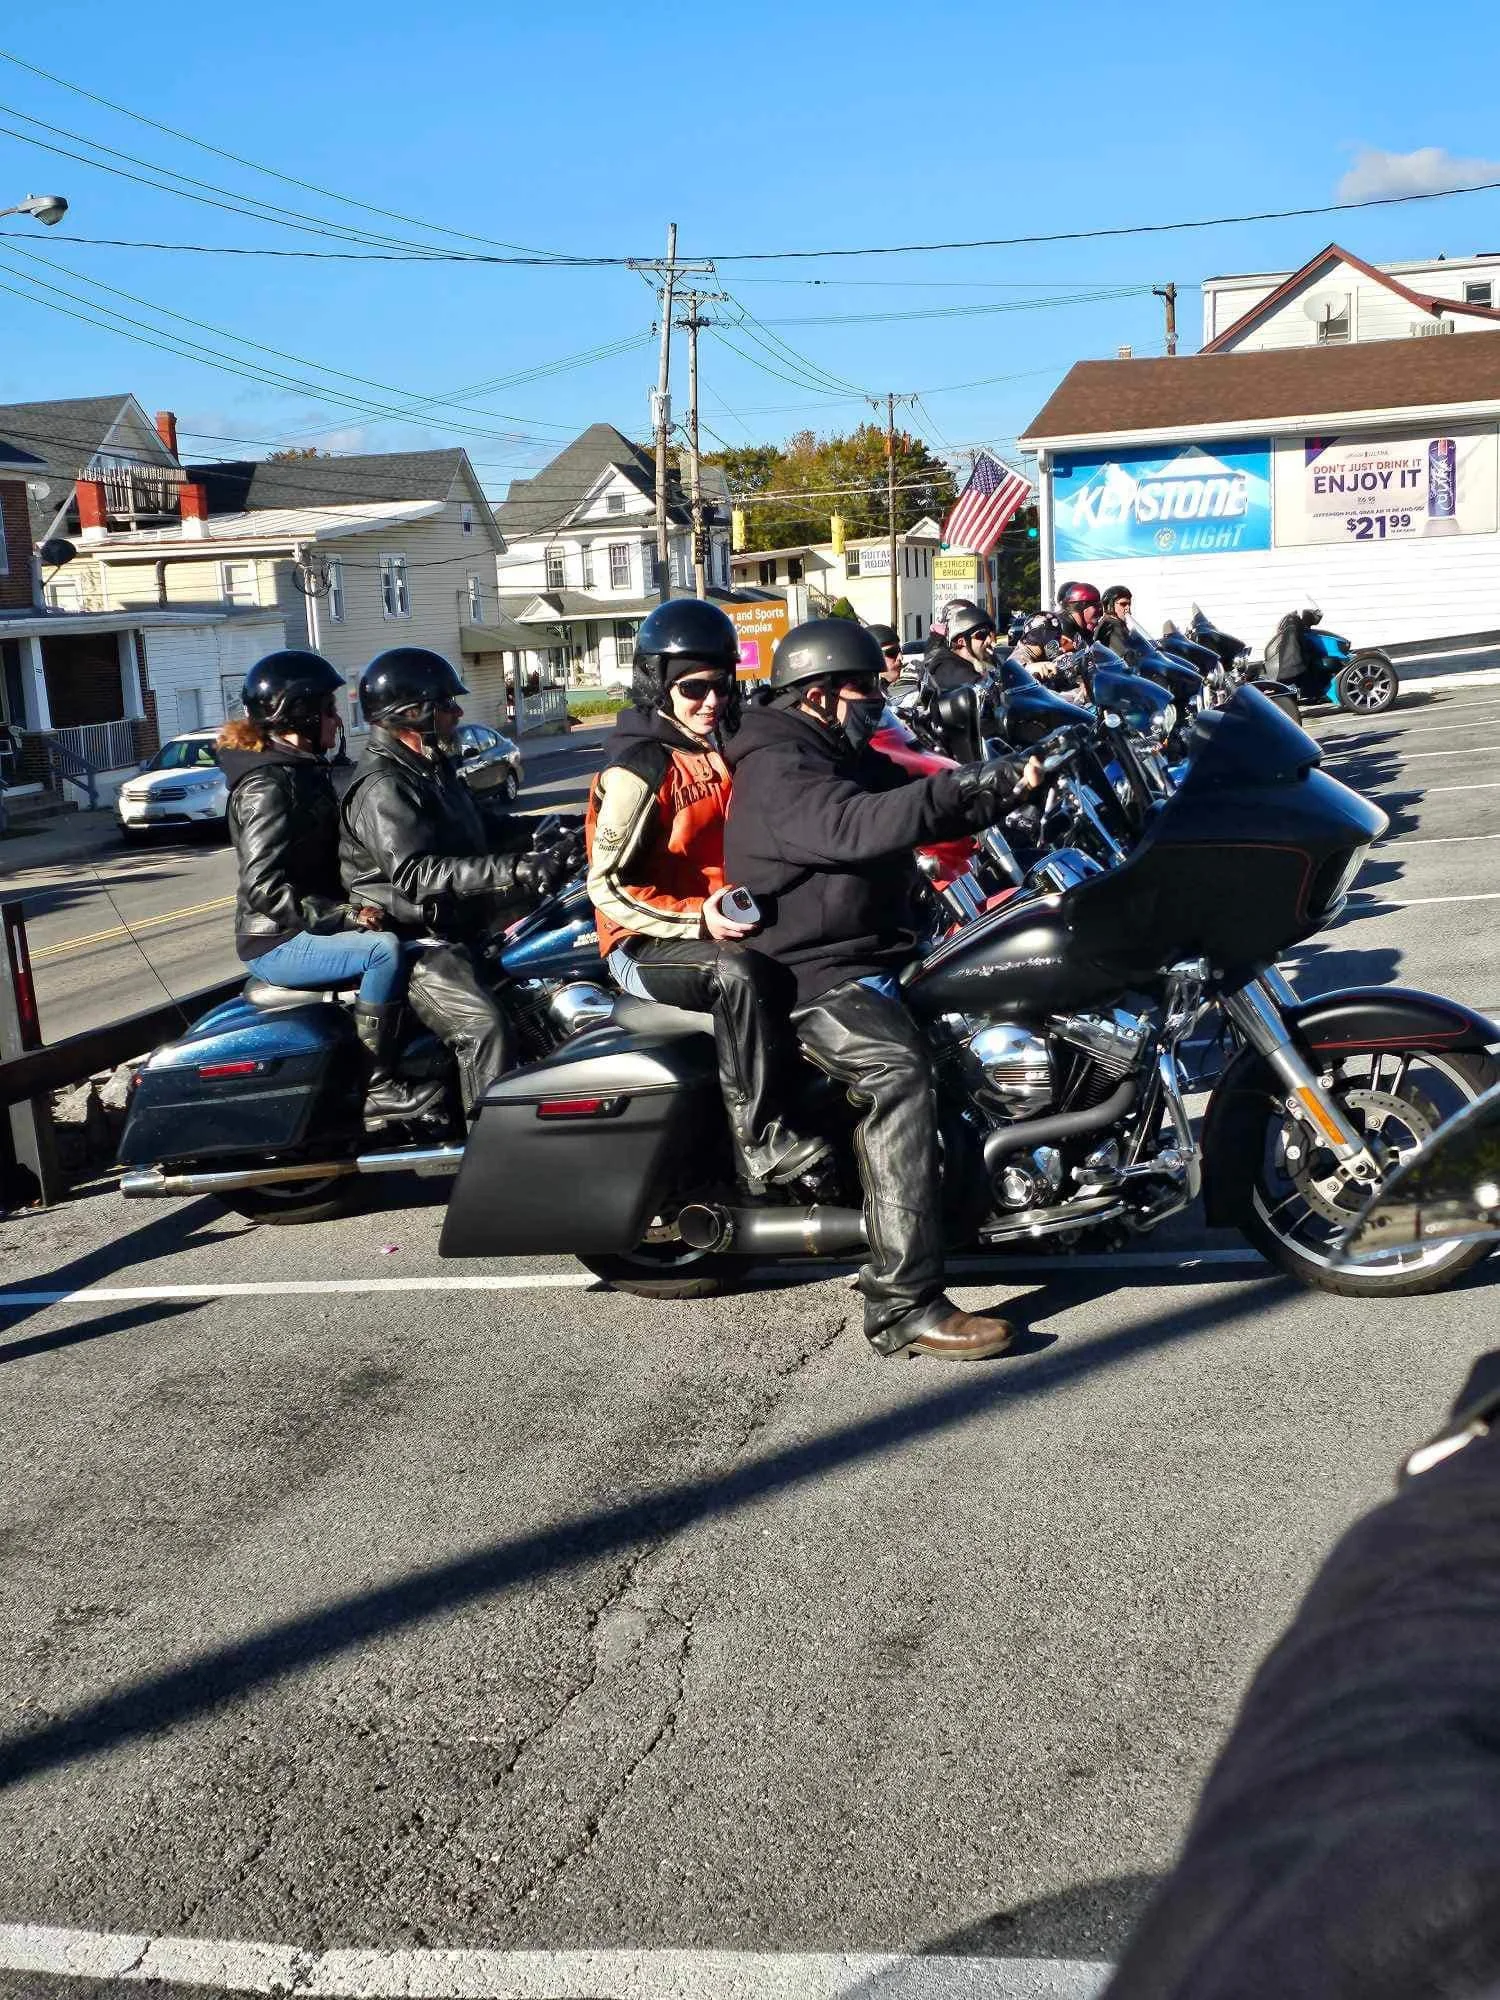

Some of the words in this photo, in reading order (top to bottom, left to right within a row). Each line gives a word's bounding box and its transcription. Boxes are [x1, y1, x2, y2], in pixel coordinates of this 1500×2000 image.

[1313, 464, 1346, 475] DON'T
[1348, 461, 1374, 473] JUST
[1376, 459, 1409, 470] DRINK
[1412, 458, 1422, 466] IT
[1314, 471, 1393, 494] ENJOY
[1400, 469, 1422, 489] IT
[1072, 474, 1248, 529] KEYSTONE
[1180, 523, 1248, 550] LIGHT
[935, 560, 975, 569] RESTRICTED
[942, 569, 966, 577] BRIDGE
[736, 610, 753, 621] and
[754, 608, 785, 620] Sports
[735, 622, 773, 635] Complex
